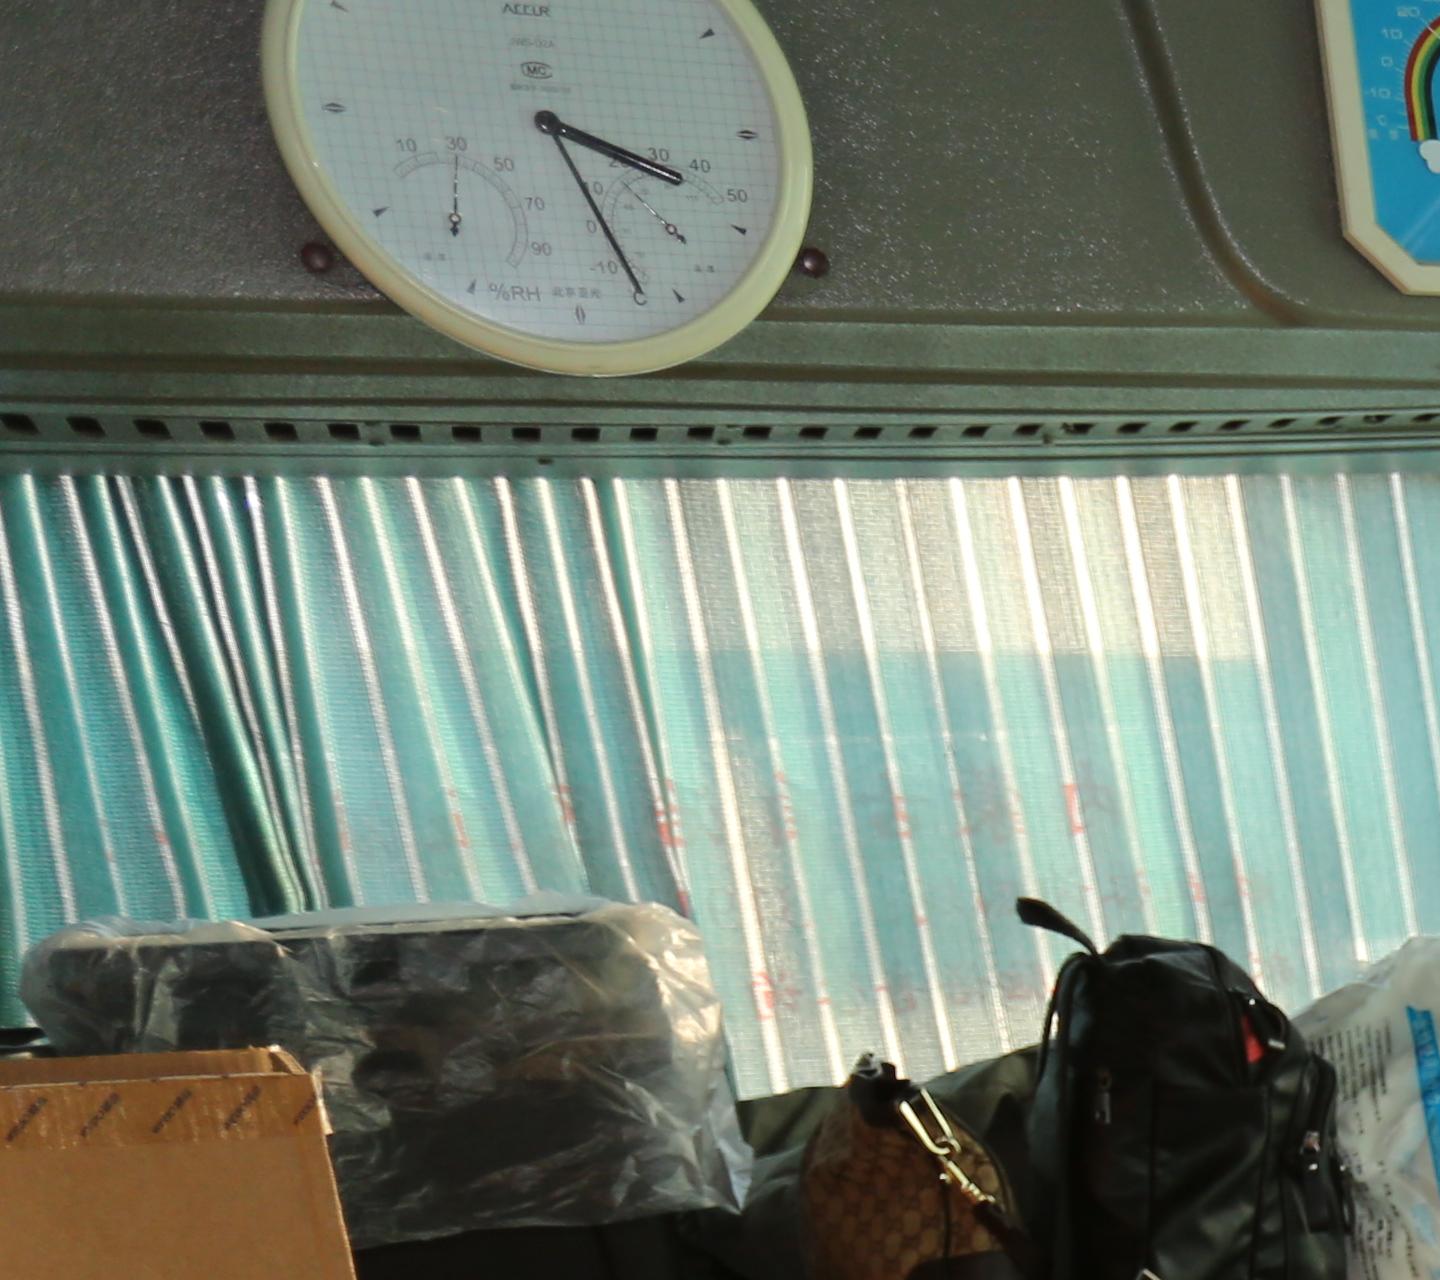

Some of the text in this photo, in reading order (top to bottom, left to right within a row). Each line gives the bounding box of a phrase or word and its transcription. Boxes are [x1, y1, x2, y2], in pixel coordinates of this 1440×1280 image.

[397, 138, 417, 152] 10
[446, 136, 467, 151] 30
[648, 148, 670, 162] 30
[494, 157, 514, 172] 50
[690, 160, 711, 173] 40
[727, 189, 748, 203] 50
[525, 197, 545, 211] 70
[531, 242, 552, 257] 90
[489, 282, 542, 302] %RH
